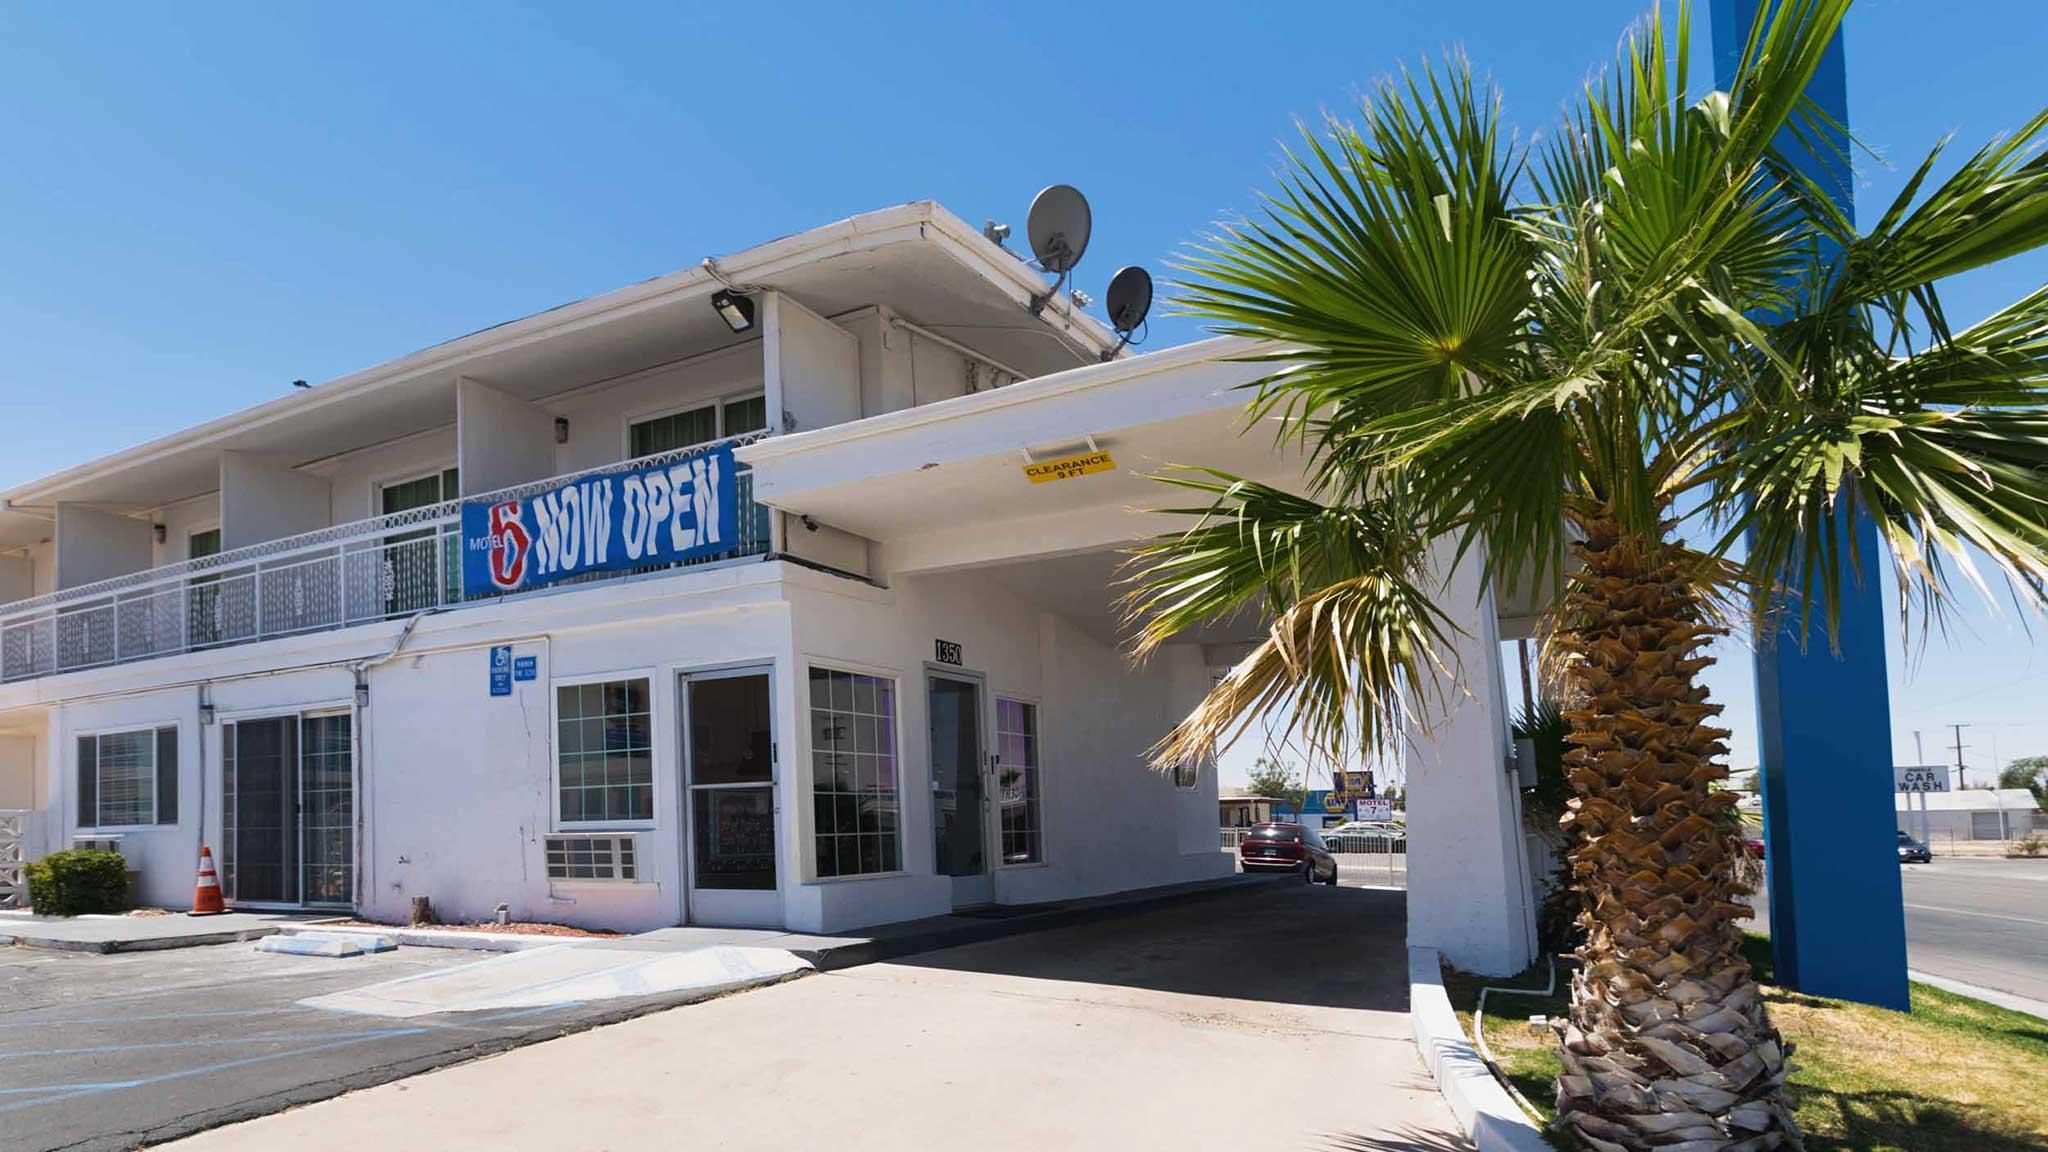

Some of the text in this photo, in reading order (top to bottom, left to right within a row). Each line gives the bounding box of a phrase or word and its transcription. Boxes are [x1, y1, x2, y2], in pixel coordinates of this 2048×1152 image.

[1026, 454, 1112, 477] CLEARANCE
[1057, 467, 1085, 479] 9 FT
[532, 454, 721, 576] NOW OPEN
[469, 500, 532, 590] MOTEL 6
[937, 641, 961, 664] 1350
[1904, 773, 1935, 783] CAR
[1898, 782, 1943, 792] WASH
[1370, 806, 1377, 815] 7
